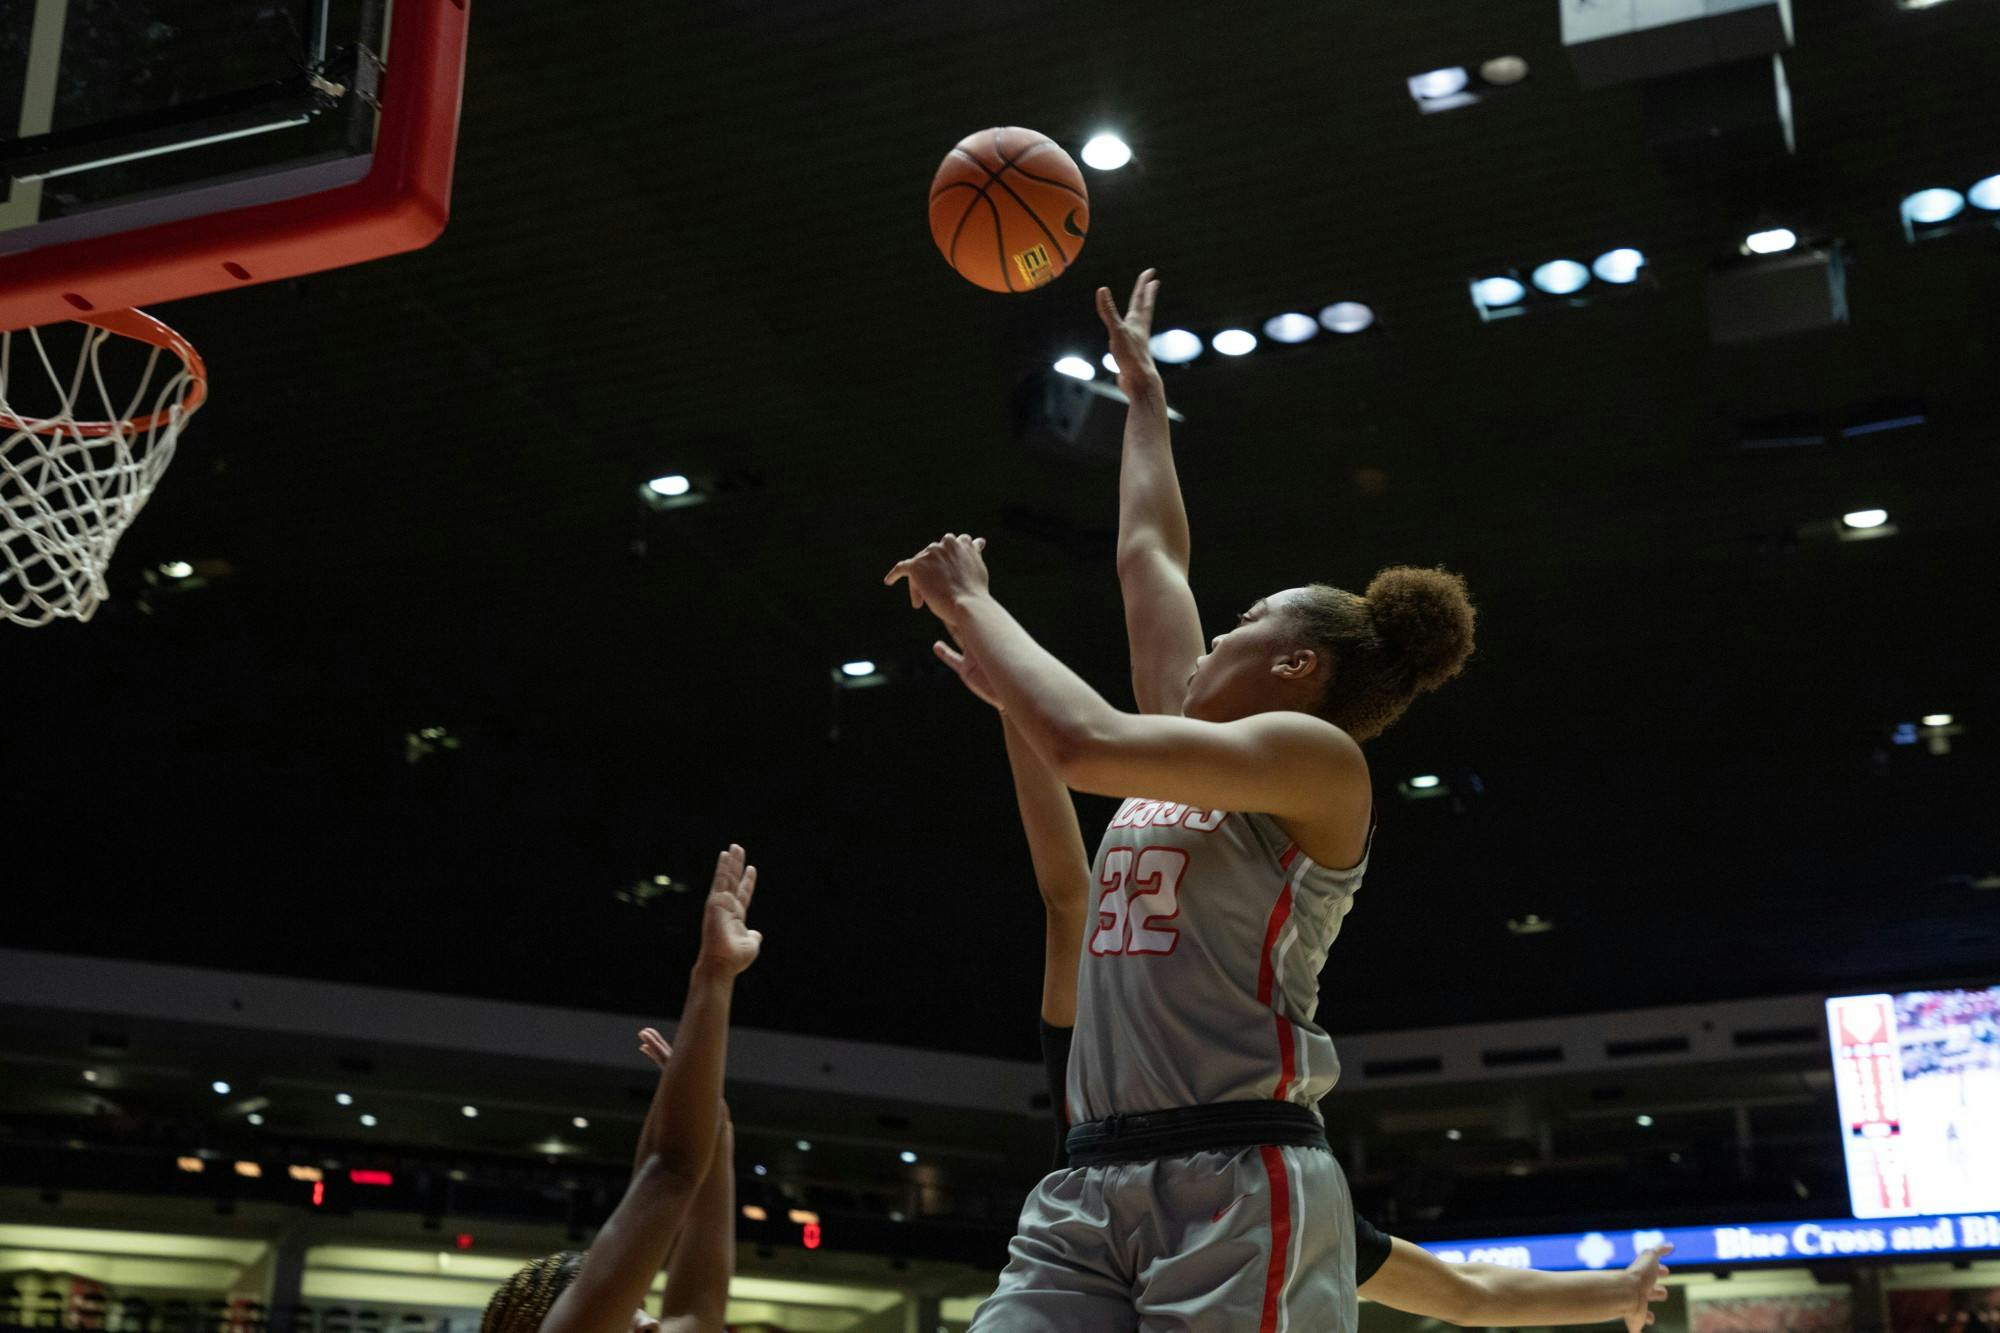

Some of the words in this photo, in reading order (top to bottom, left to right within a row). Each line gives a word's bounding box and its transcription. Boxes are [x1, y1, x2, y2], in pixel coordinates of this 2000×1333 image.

[1089, 846, 1190, 956] 32
[1715, 1227, 1788, 1259] Blue
[1792, 1223, 1886, 1254] Cross
[1891, 1217, 1955, 1250] and
